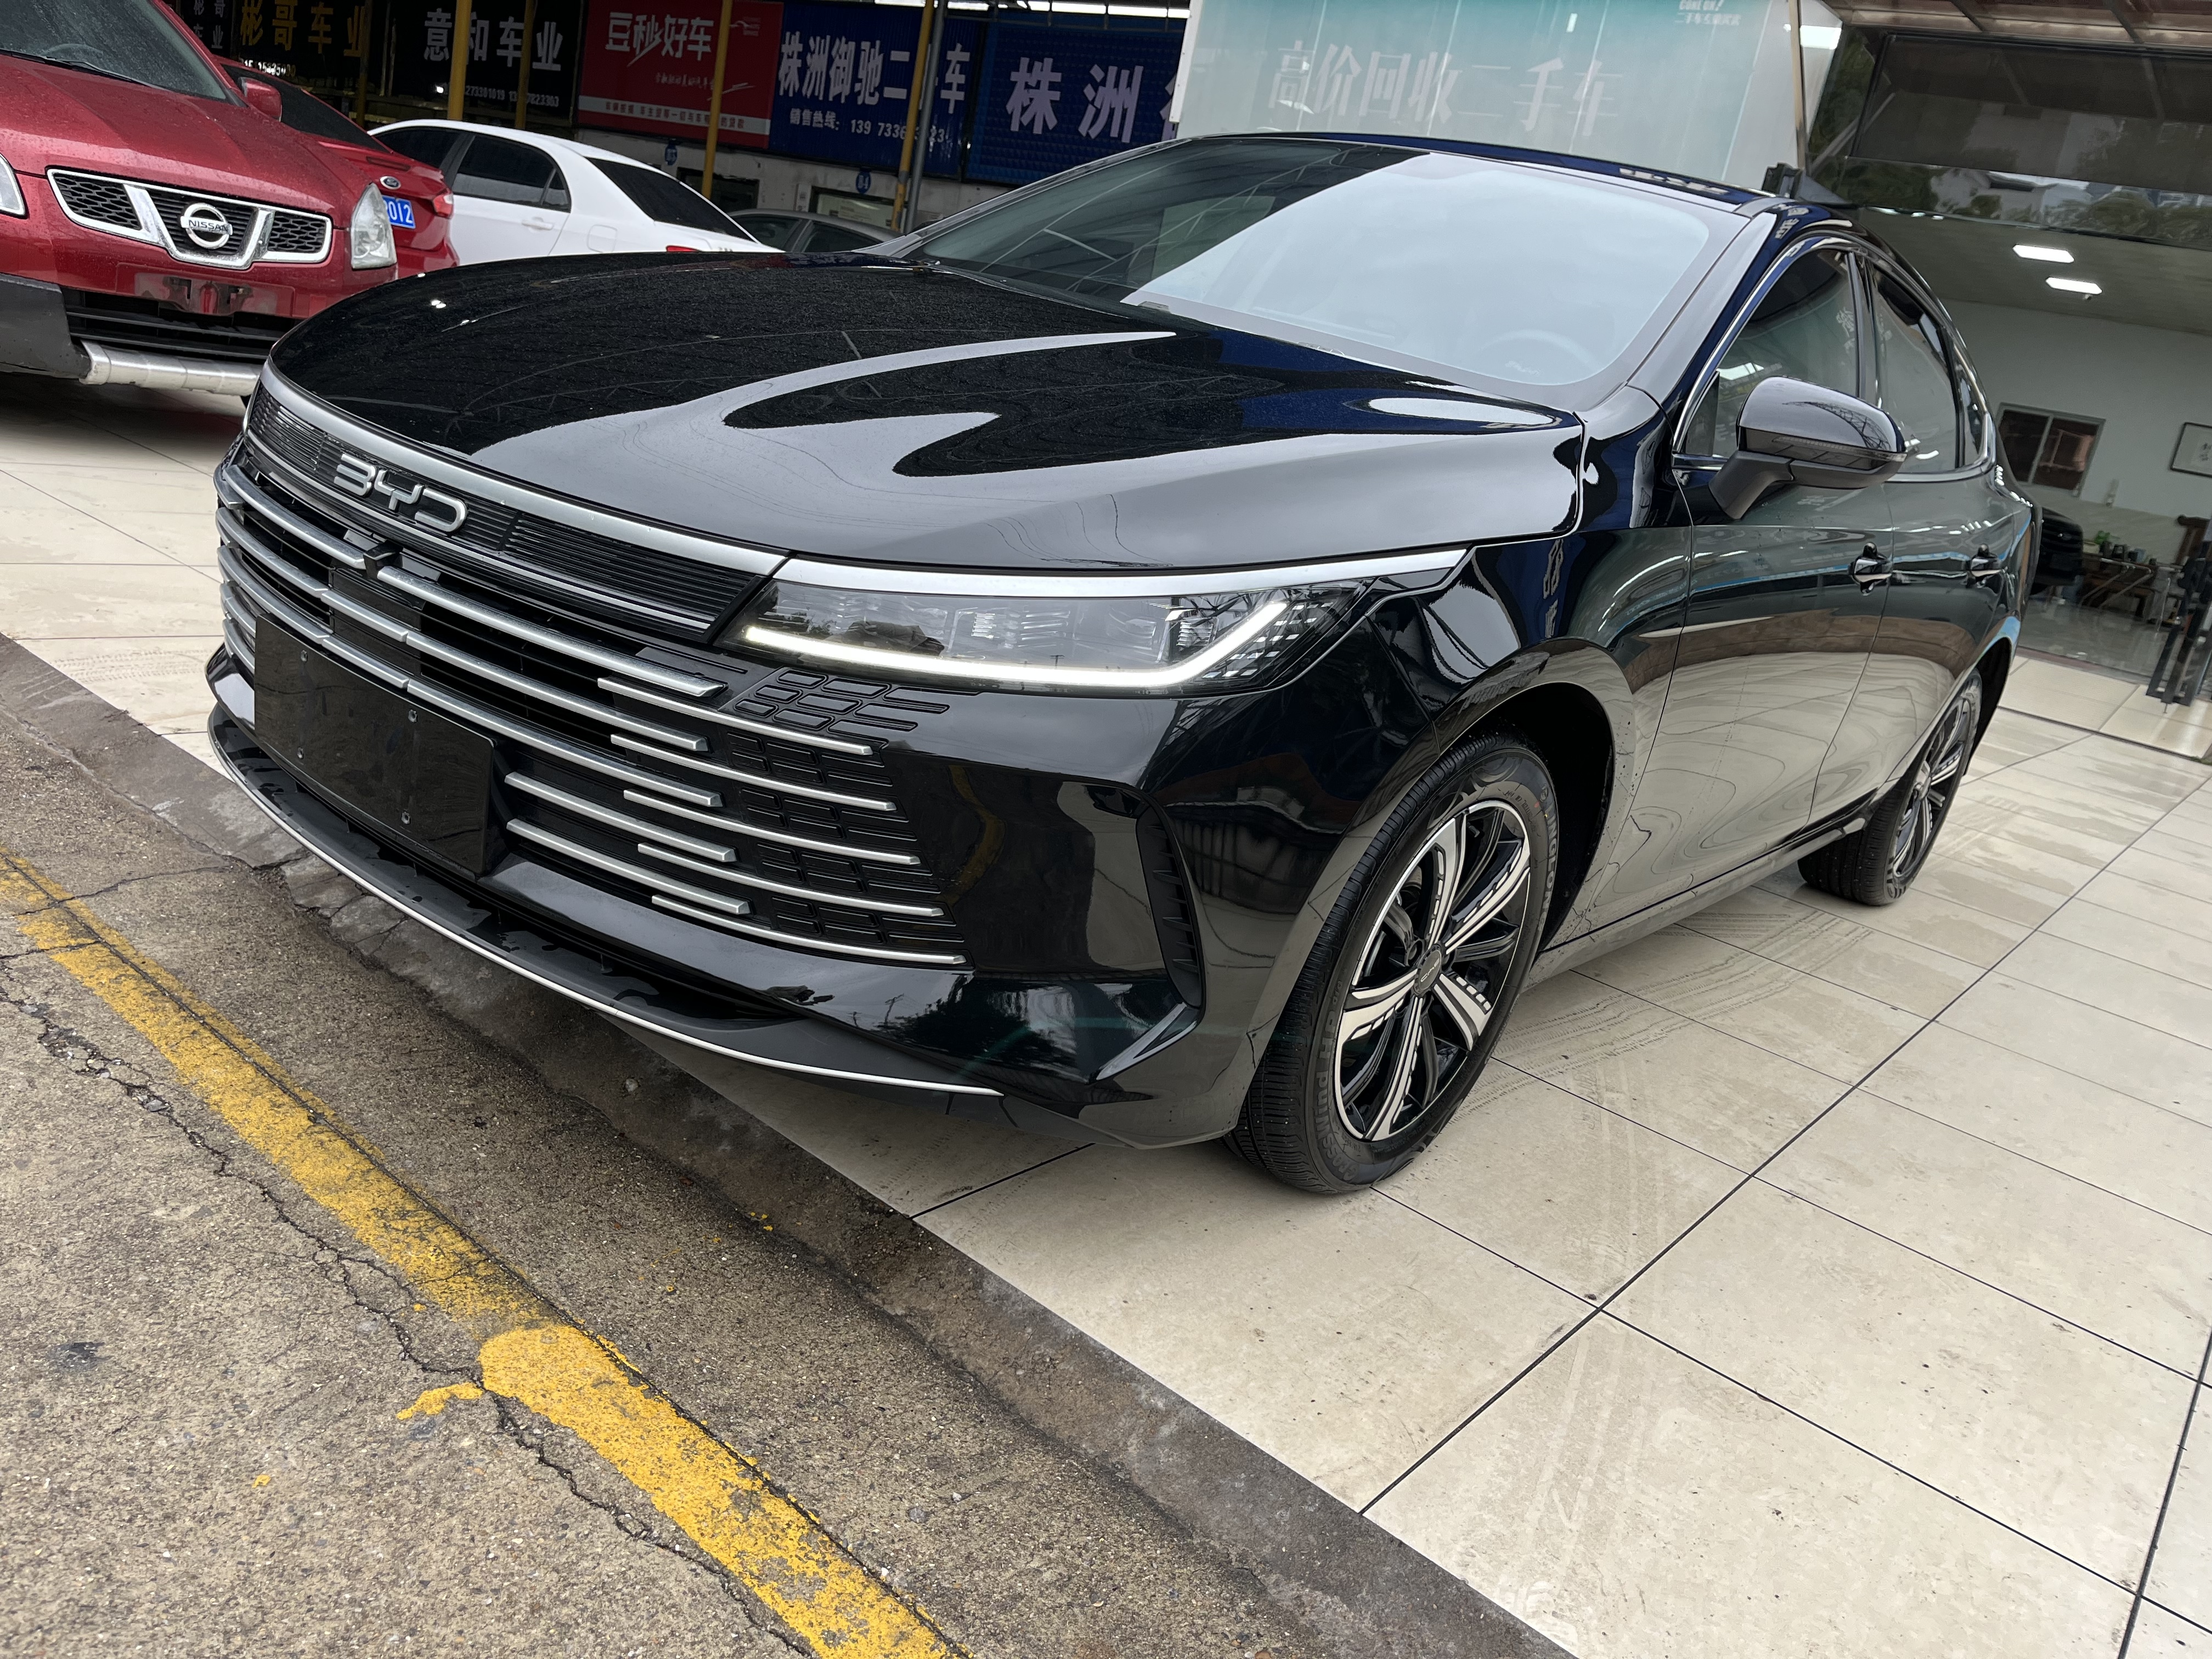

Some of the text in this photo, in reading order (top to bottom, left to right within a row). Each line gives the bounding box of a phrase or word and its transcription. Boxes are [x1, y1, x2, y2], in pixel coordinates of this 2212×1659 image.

[605, 12, 715, 66] 豆秒好车
[778, 31, 971, 114] 株洲御驰二车
[1269, 41, 1623, 137] 高价回收二手车
[851, 119, 872, 135] 139
[188, 219, 231, 233] NISSAN
[334, 453, 469, 533] BYD
